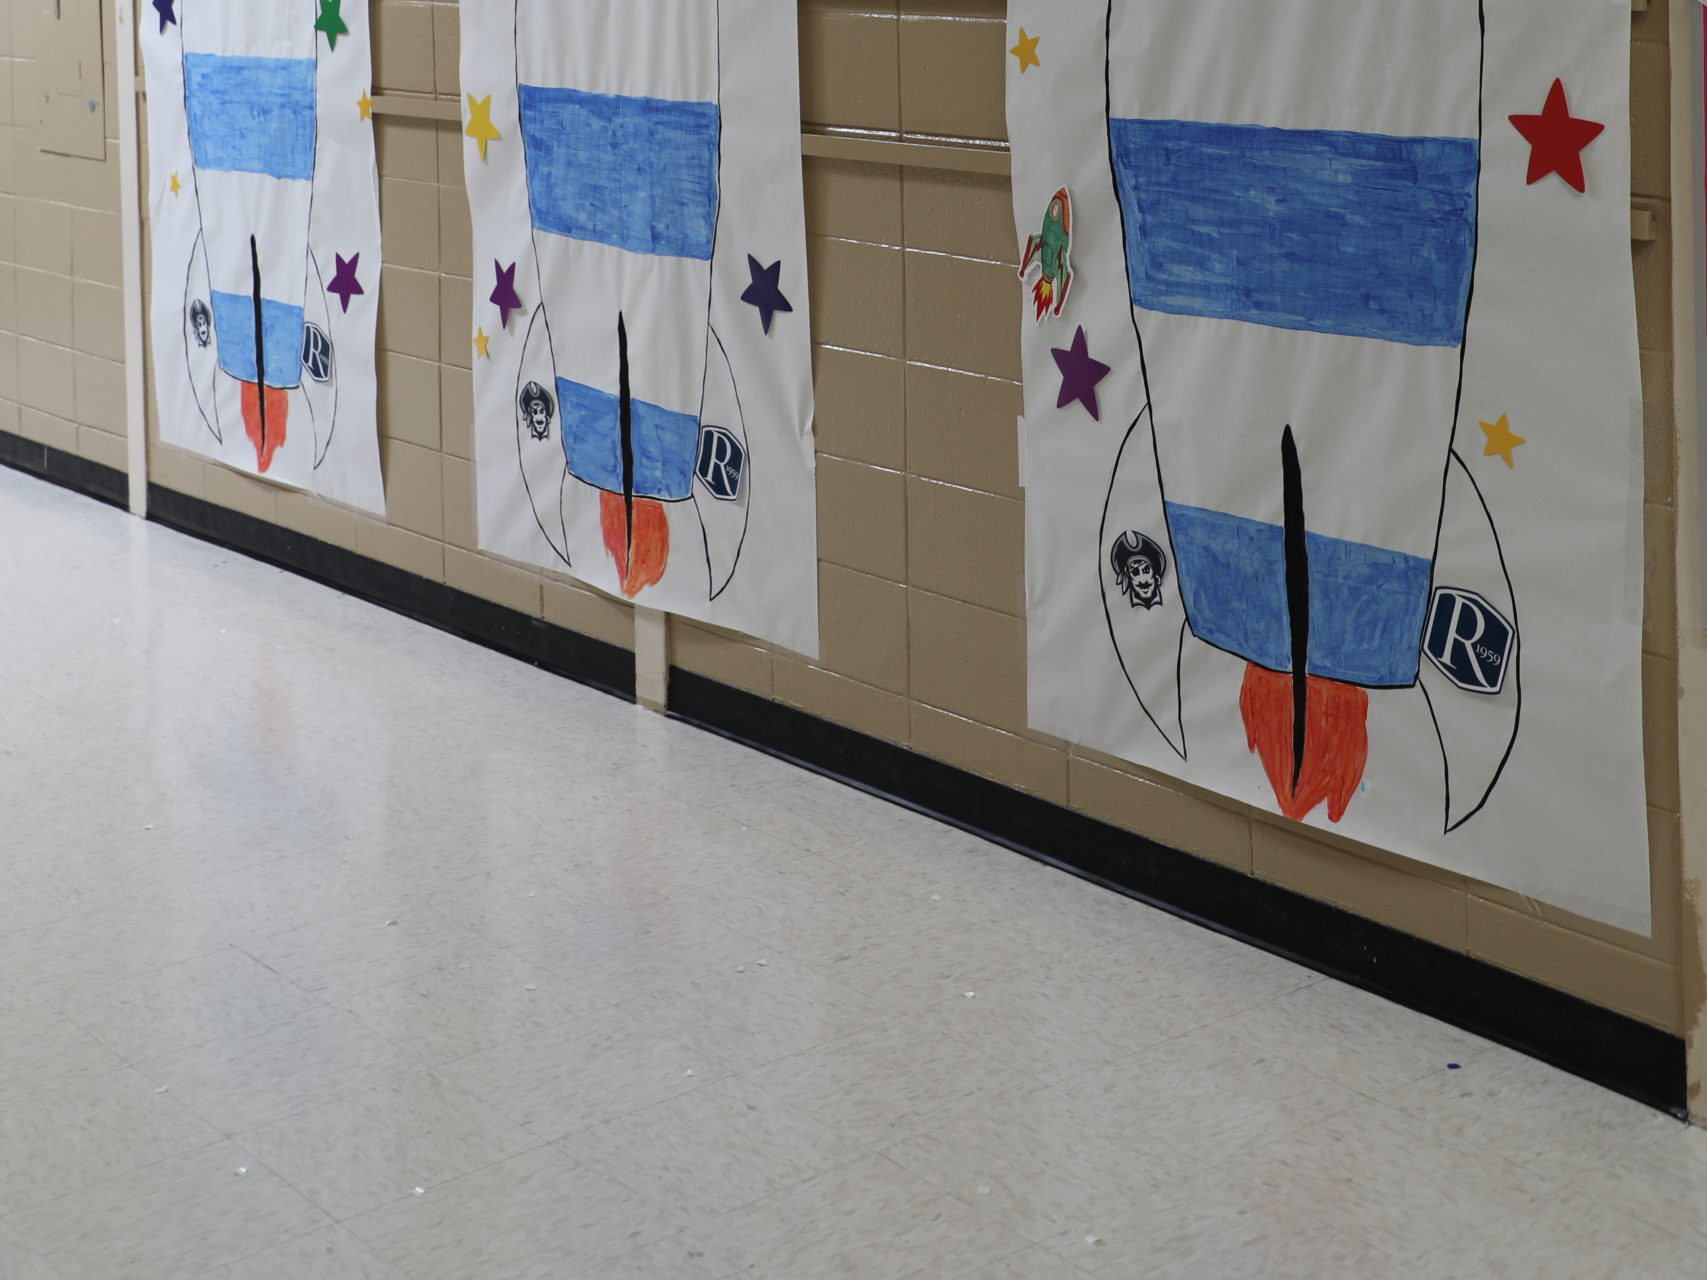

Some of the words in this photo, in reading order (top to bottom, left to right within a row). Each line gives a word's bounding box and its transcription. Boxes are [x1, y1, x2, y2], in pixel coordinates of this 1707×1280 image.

[307, 326, 326, 378] R
[705, 431, 734, 497] R
[1437, 592, 1492, 688] R
[1475, 643, 1501, 666] 1959
